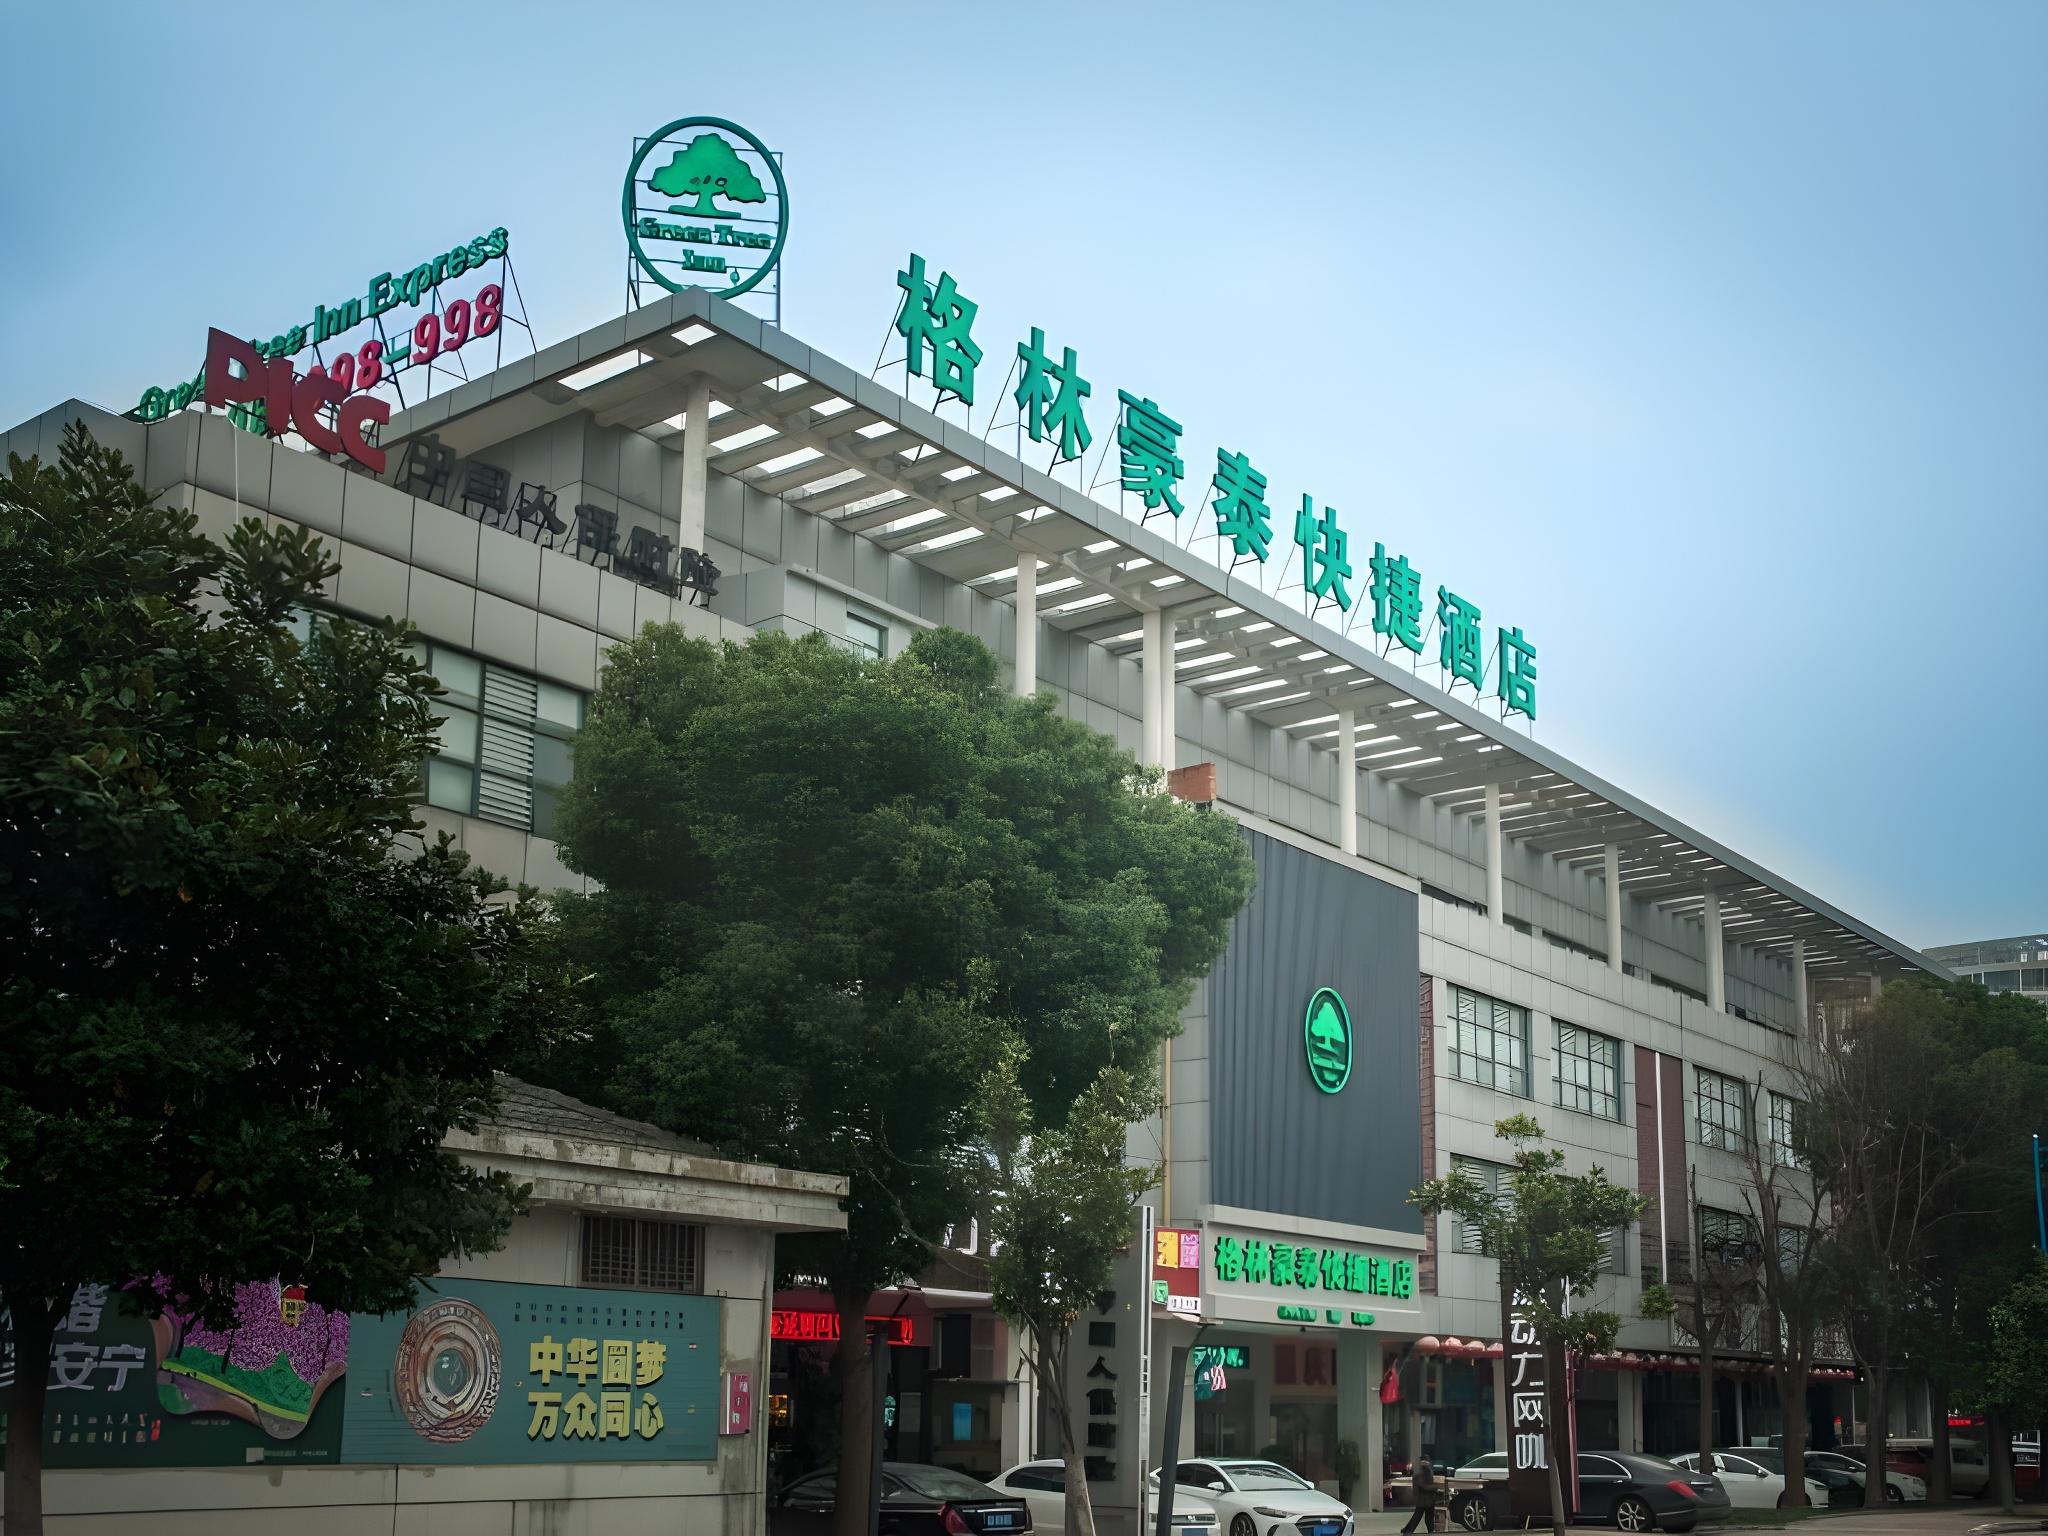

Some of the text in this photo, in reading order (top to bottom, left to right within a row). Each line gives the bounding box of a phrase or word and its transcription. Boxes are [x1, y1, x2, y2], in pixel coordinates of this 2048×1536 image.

[140, 373, 206, 420] Gre
[254, 324, 307, 359] ree
[313, 304, 362, 345] Inn
[368, 227, 508, 318] Express
[308, 284, 503, 398] 98-998
[204, 327, 390, 475] PICC
[896, 253, 1537, 721] 格林豪泰快捷酒店
[527, 1392, 665, 1441] 万众同心
[529, 1335, 667, 1387] 中华圆梦
